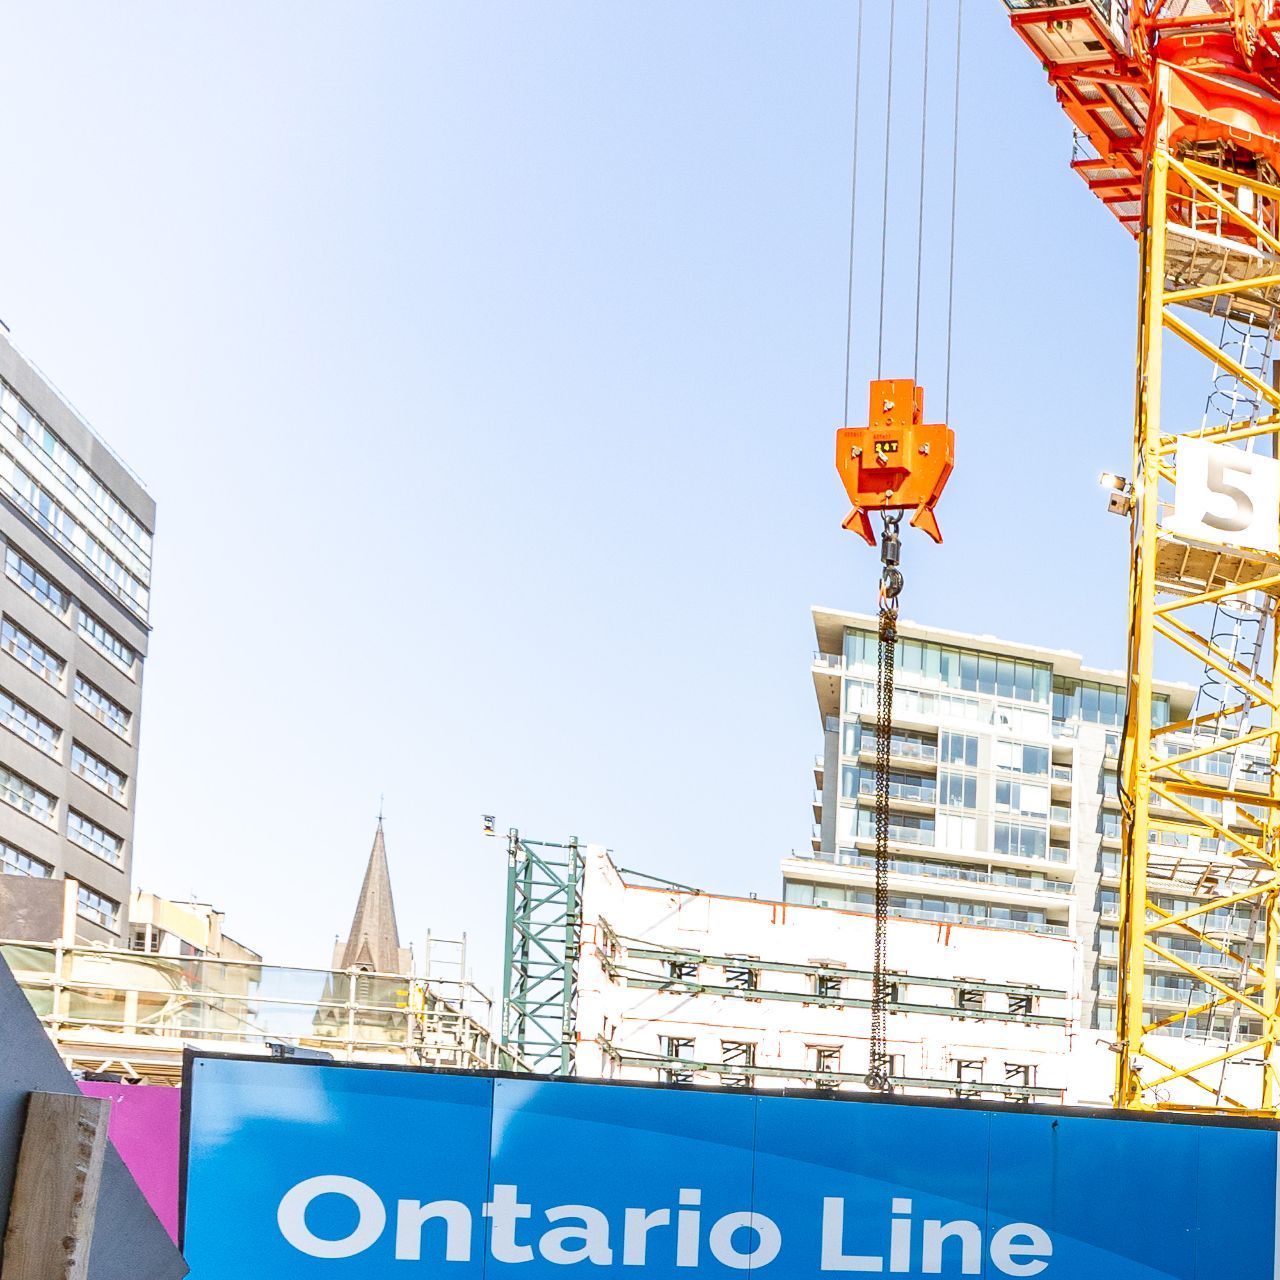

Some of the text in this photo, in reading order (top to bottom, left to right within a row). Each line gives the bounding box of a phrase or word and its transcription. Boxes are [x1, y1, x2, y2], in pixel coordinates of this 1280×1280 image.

[1201, 467, 1254, 532] 5
[277, 1174, 1053, 1277] Ontario Line
